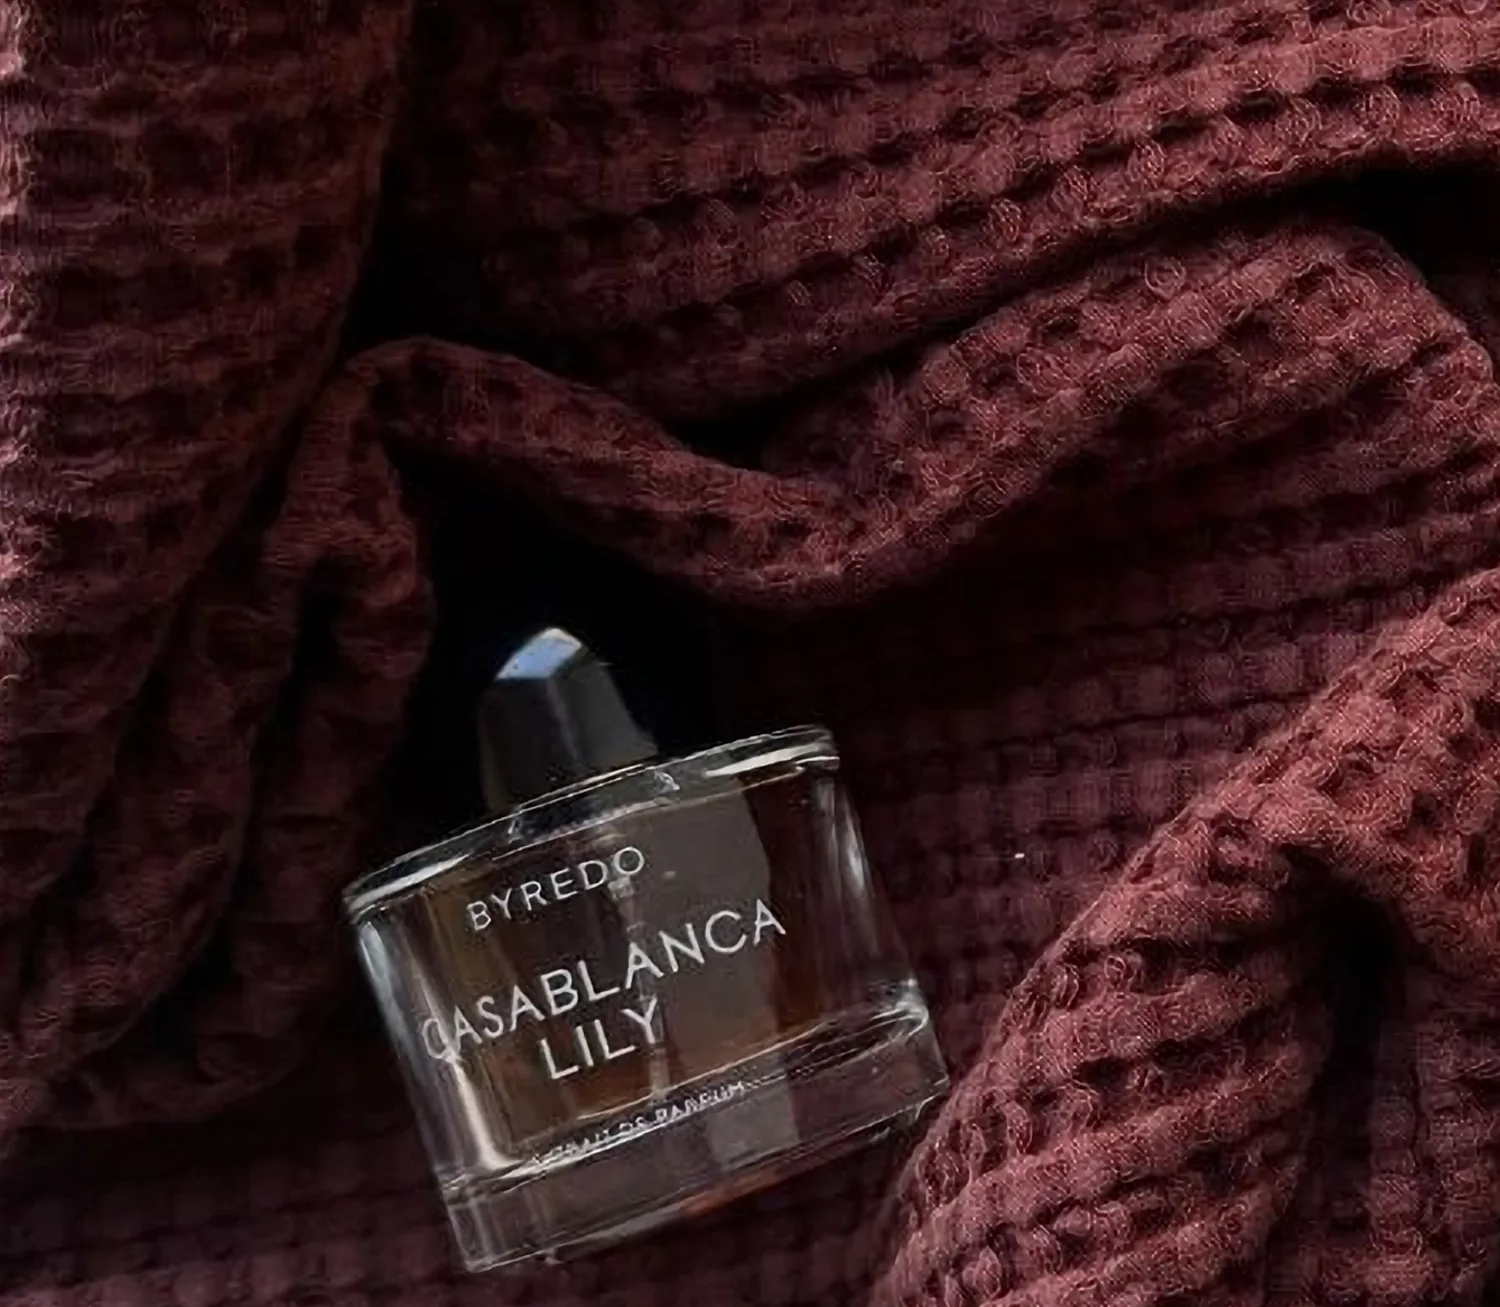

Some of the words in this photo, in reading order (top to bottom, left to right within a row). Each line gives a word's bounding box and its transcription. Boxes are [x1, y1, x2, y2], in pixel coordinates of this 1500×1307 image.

[467, 846, 647, 931] BYREDO
[421, 898, 787, 1062] CASABLANCA
[538, 998, 665, 1080] LILY
[655, 1083, 745, 1129] PARFUM
